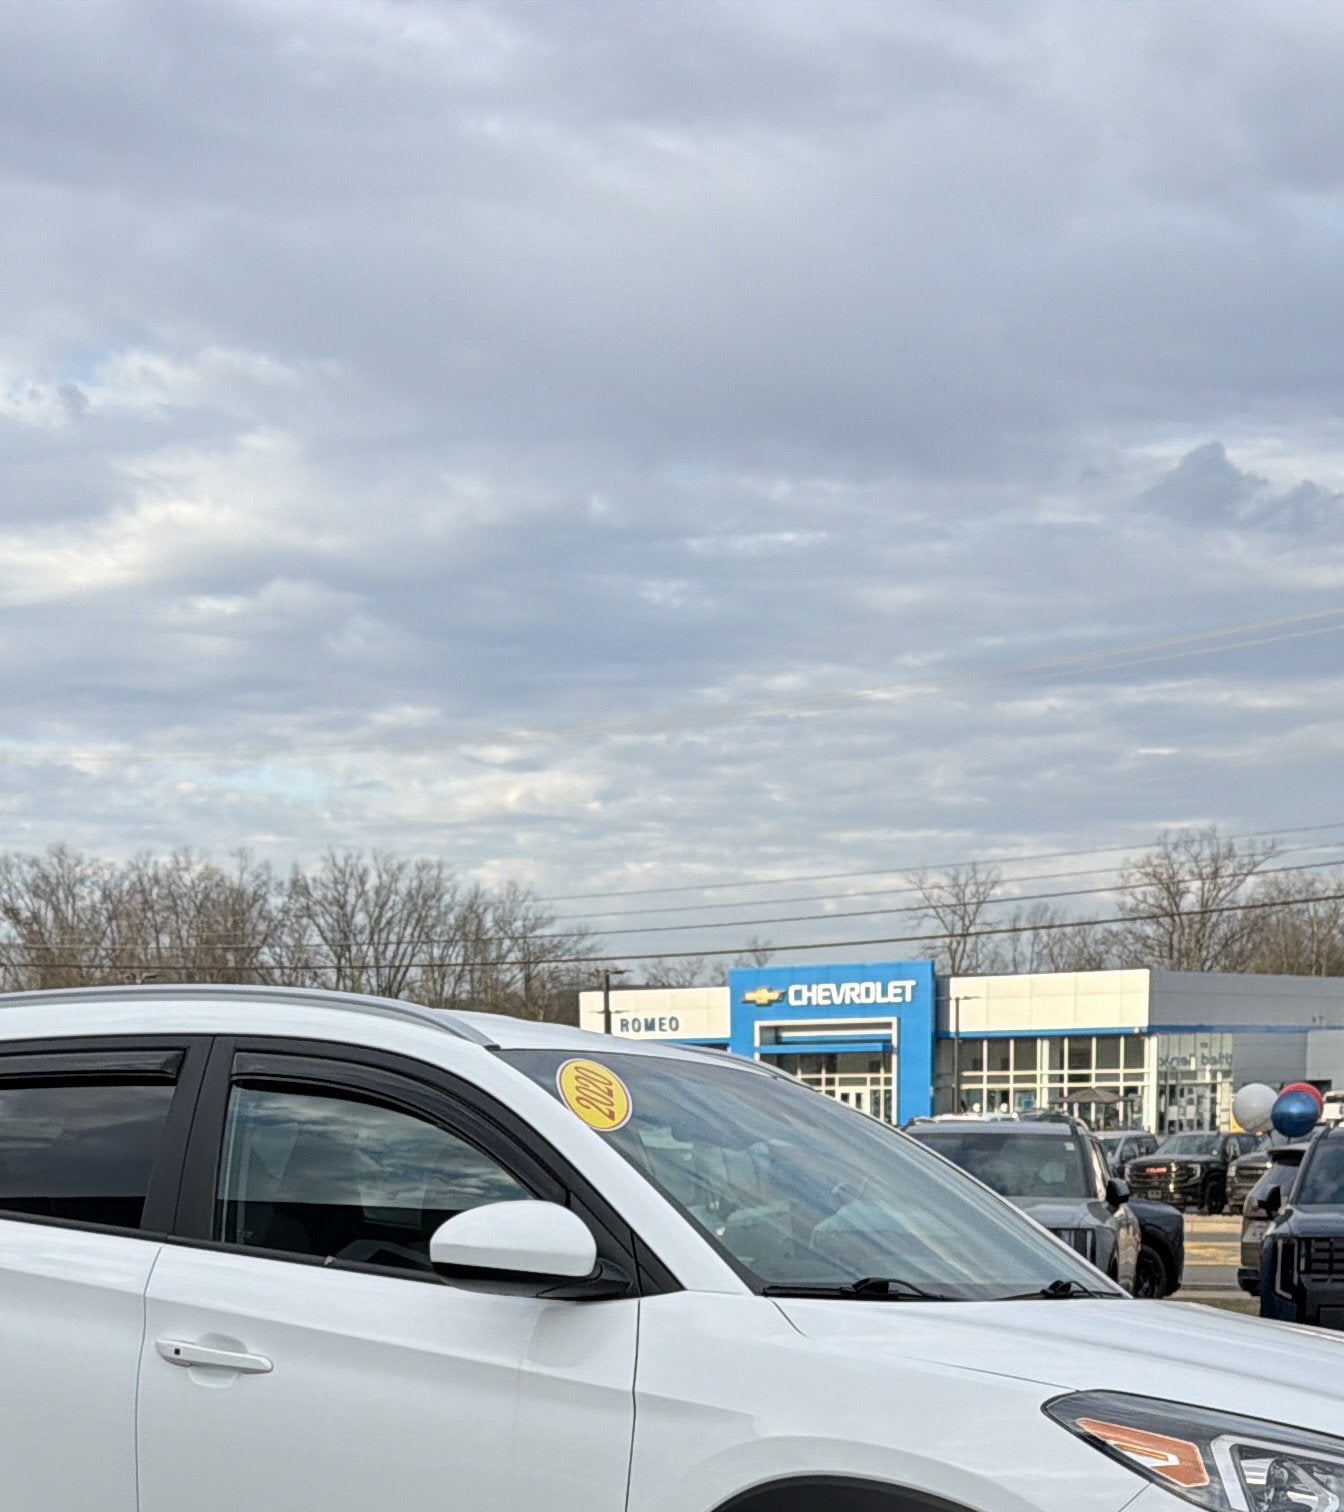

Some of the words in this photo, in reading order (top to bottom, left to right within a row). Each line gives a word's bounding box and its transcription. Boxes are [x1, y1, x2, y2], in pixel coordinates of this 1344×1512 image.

[788, 980, 917, 1007] CHEVROLET
[619, 1016, 680, 1033] ROMEO
[574, 1065, 616, 1122] 2020
